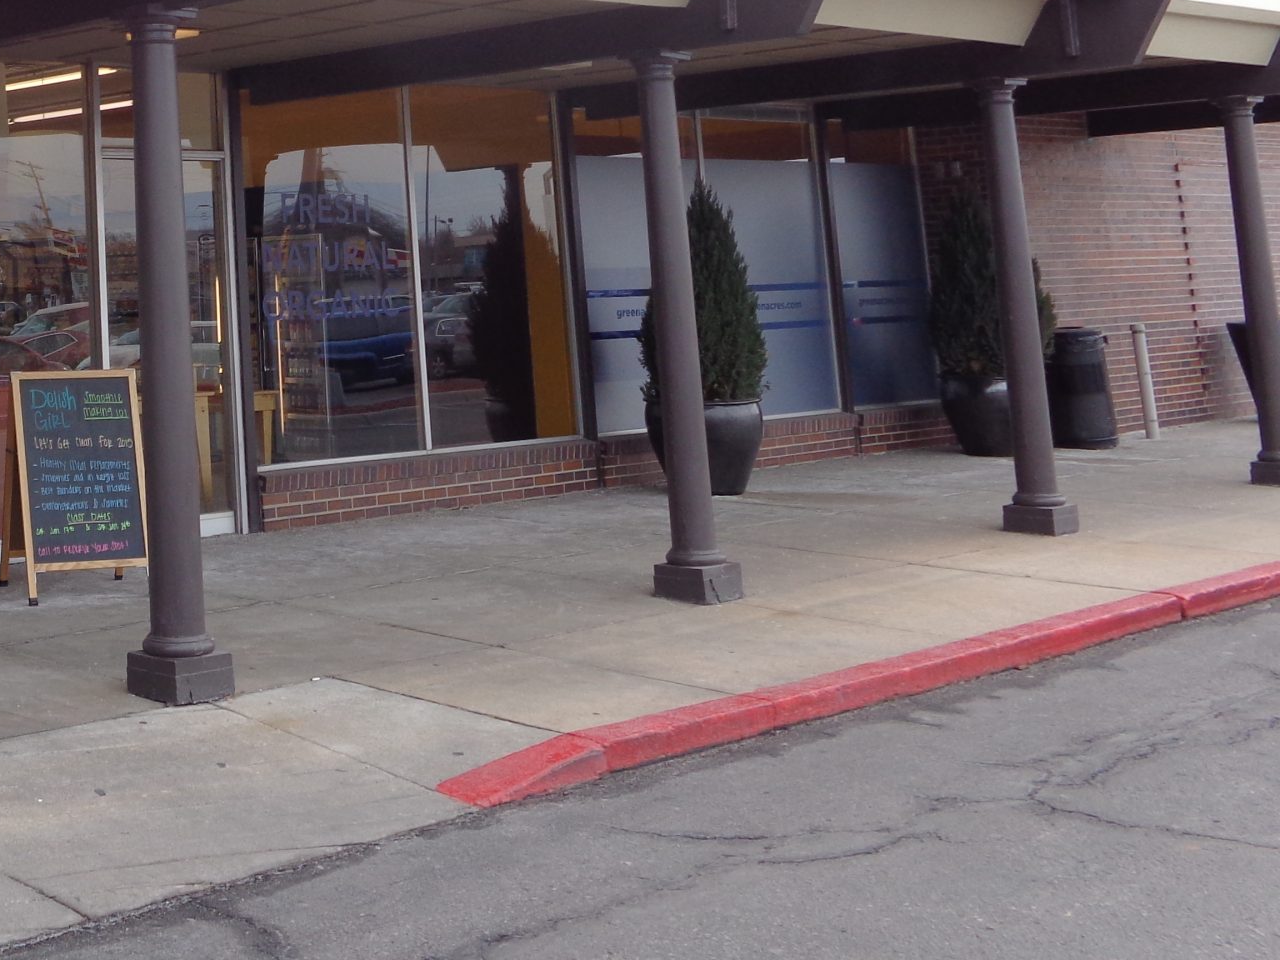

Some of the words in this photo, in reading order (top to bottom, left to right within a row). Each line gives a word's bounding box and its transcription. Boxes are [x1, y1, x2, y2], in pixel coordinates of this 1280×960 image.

[281, 192, 371, 225] FRESH
[261, 240, 396, 275] NATURAL
[262, 287, 401, 321] ORGANIC
[616, 309, 647, 319] greena
[29, 386, 77, 410] Delish
[84, 391, 123, 403] Smoothie
[115, 408, 128, 418] 101
[34, 435, 53, 450] Let's
[57, 436, 70, 449] Get
[117, 436, 133, 448] 2015
